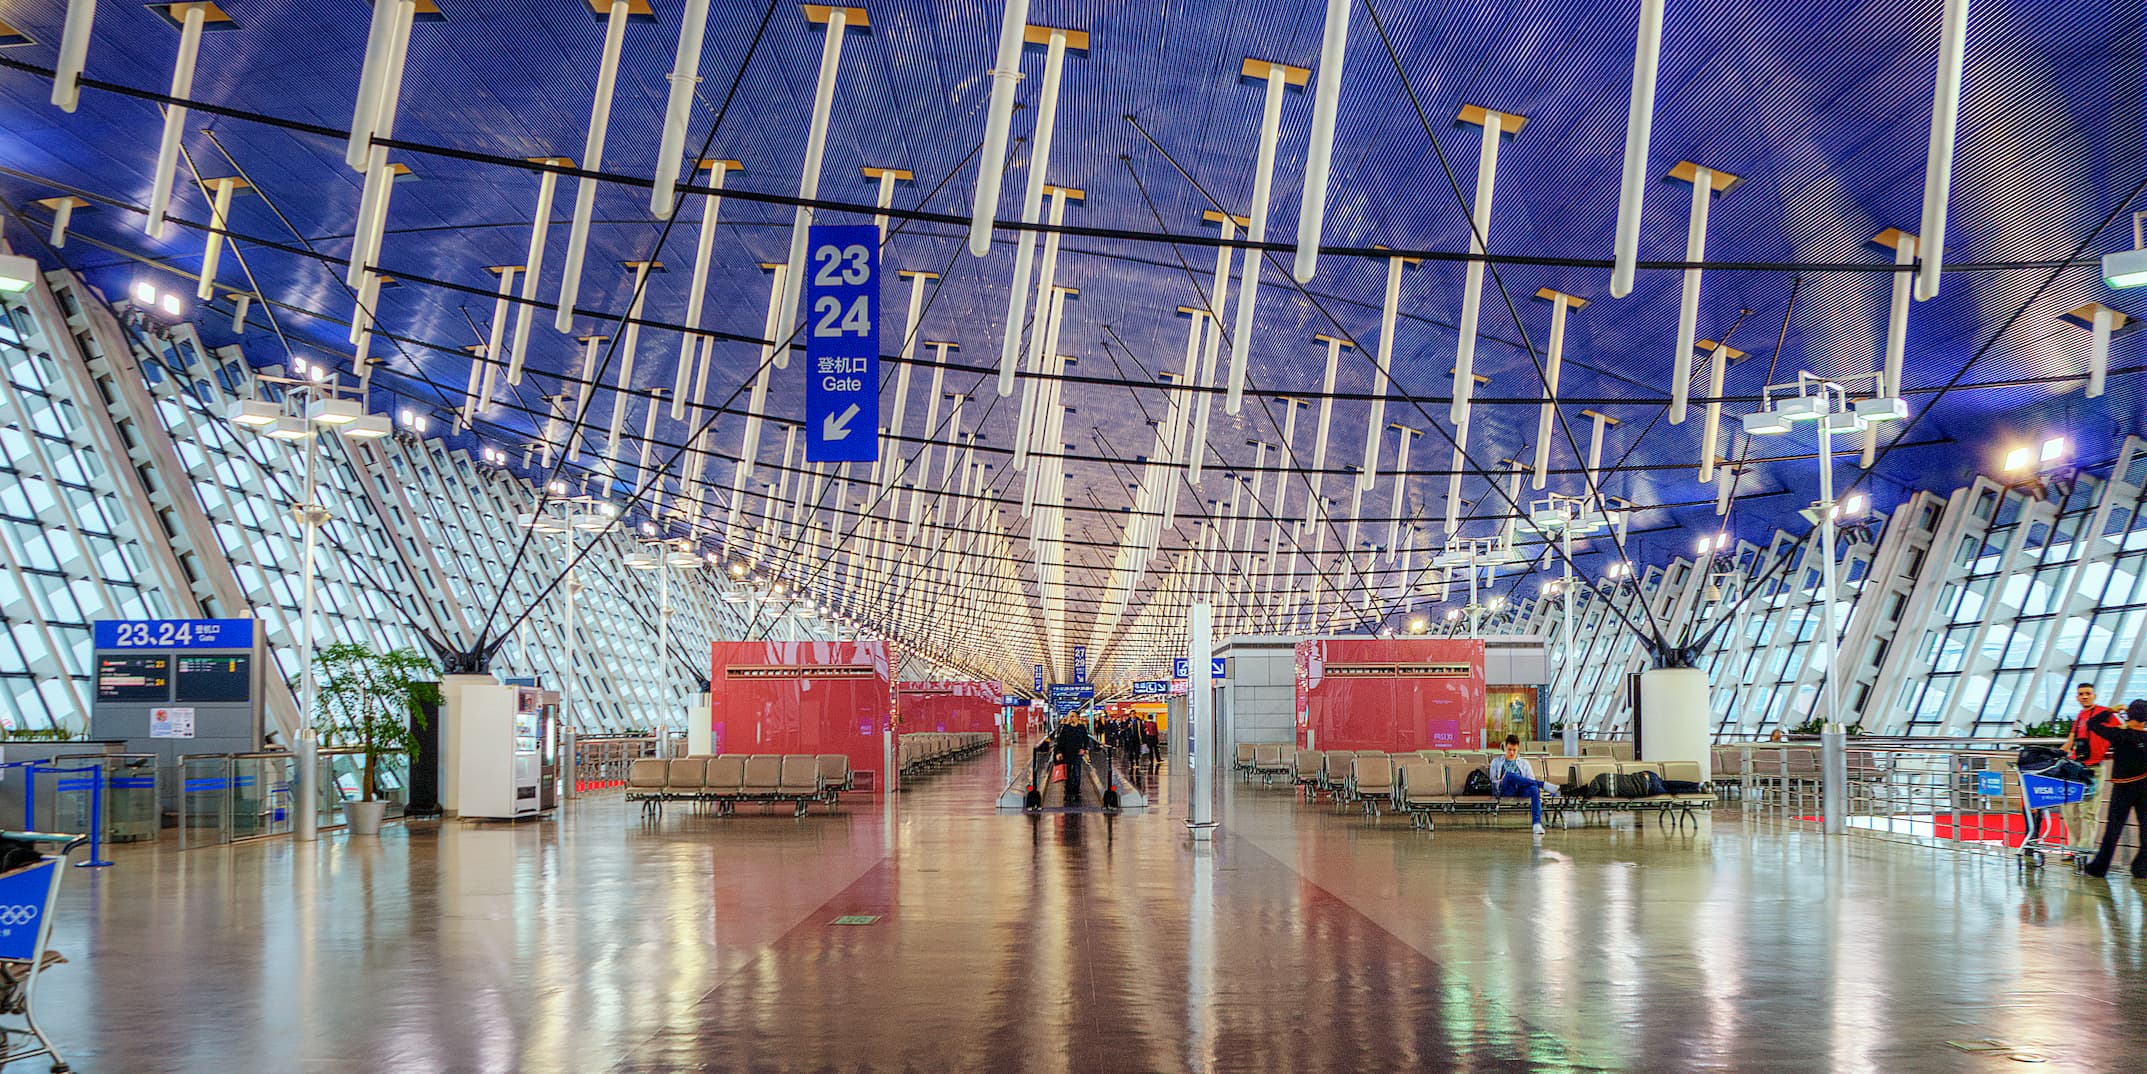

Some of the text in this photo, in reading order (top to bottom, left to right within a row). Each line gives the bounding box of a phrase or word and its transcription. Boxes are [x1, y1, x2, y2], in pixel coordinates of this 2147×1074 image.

[814, 244, 871, 286] 23
[814, 295, 871, 337] 24
[817, 357, 867, 374] 登机口
[822, 376, 862, 392] Gate
